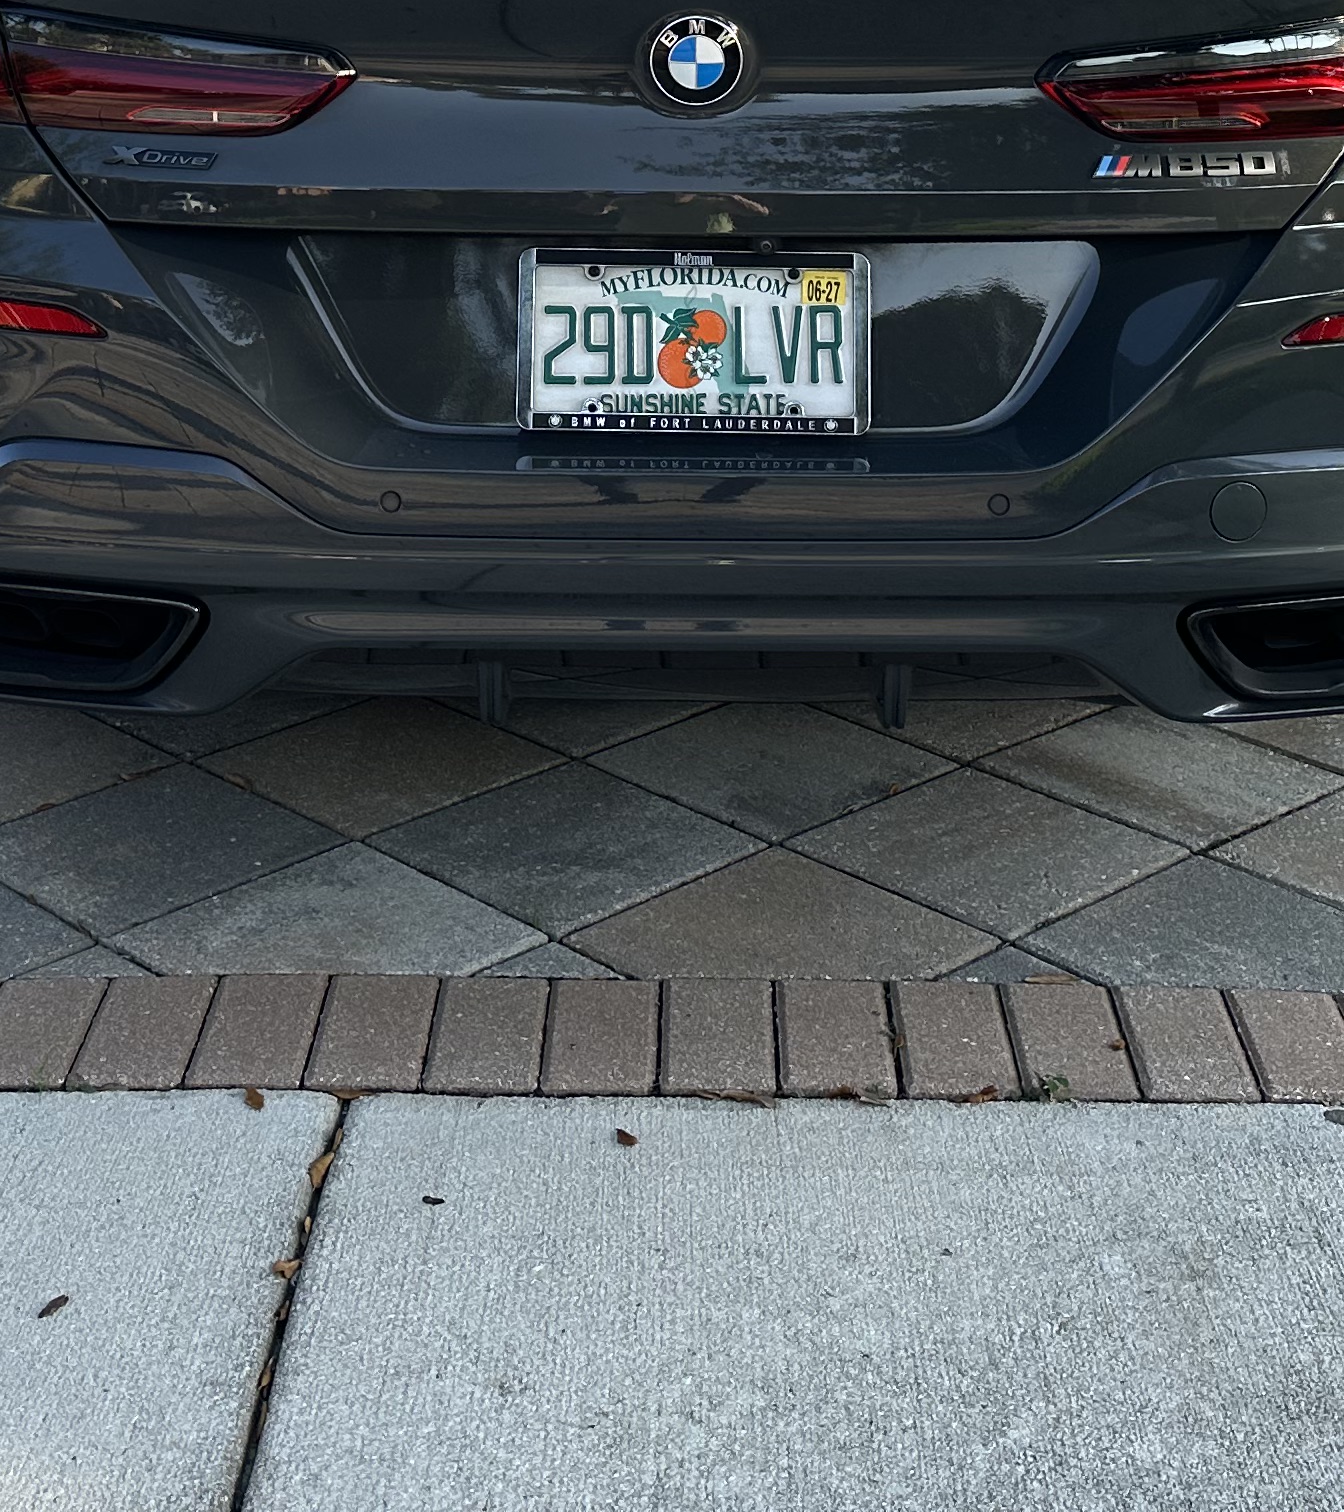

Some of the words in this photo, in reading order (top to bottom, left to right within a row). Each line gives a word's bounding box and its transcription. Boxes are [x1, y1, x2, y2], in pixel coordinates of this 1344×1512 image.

[659, 19, 736, 48] BMW
[600, 268, 789, 298] MYFLORIDA.COM
[807, 279, 841, 303] 06-27
[544, 305, 655, 385] 29D
[734, 305, 844, 385] LVR
[600, 393, 707, 414] SUNSHINE
[718, 393, 787, 416] STATE
[571, 416, 606, 427] BMW
[619, 417, 635, 428] of
[650, 417, 691, 429] FORT
[702, 418, 816, 431] LAUDERDALE
